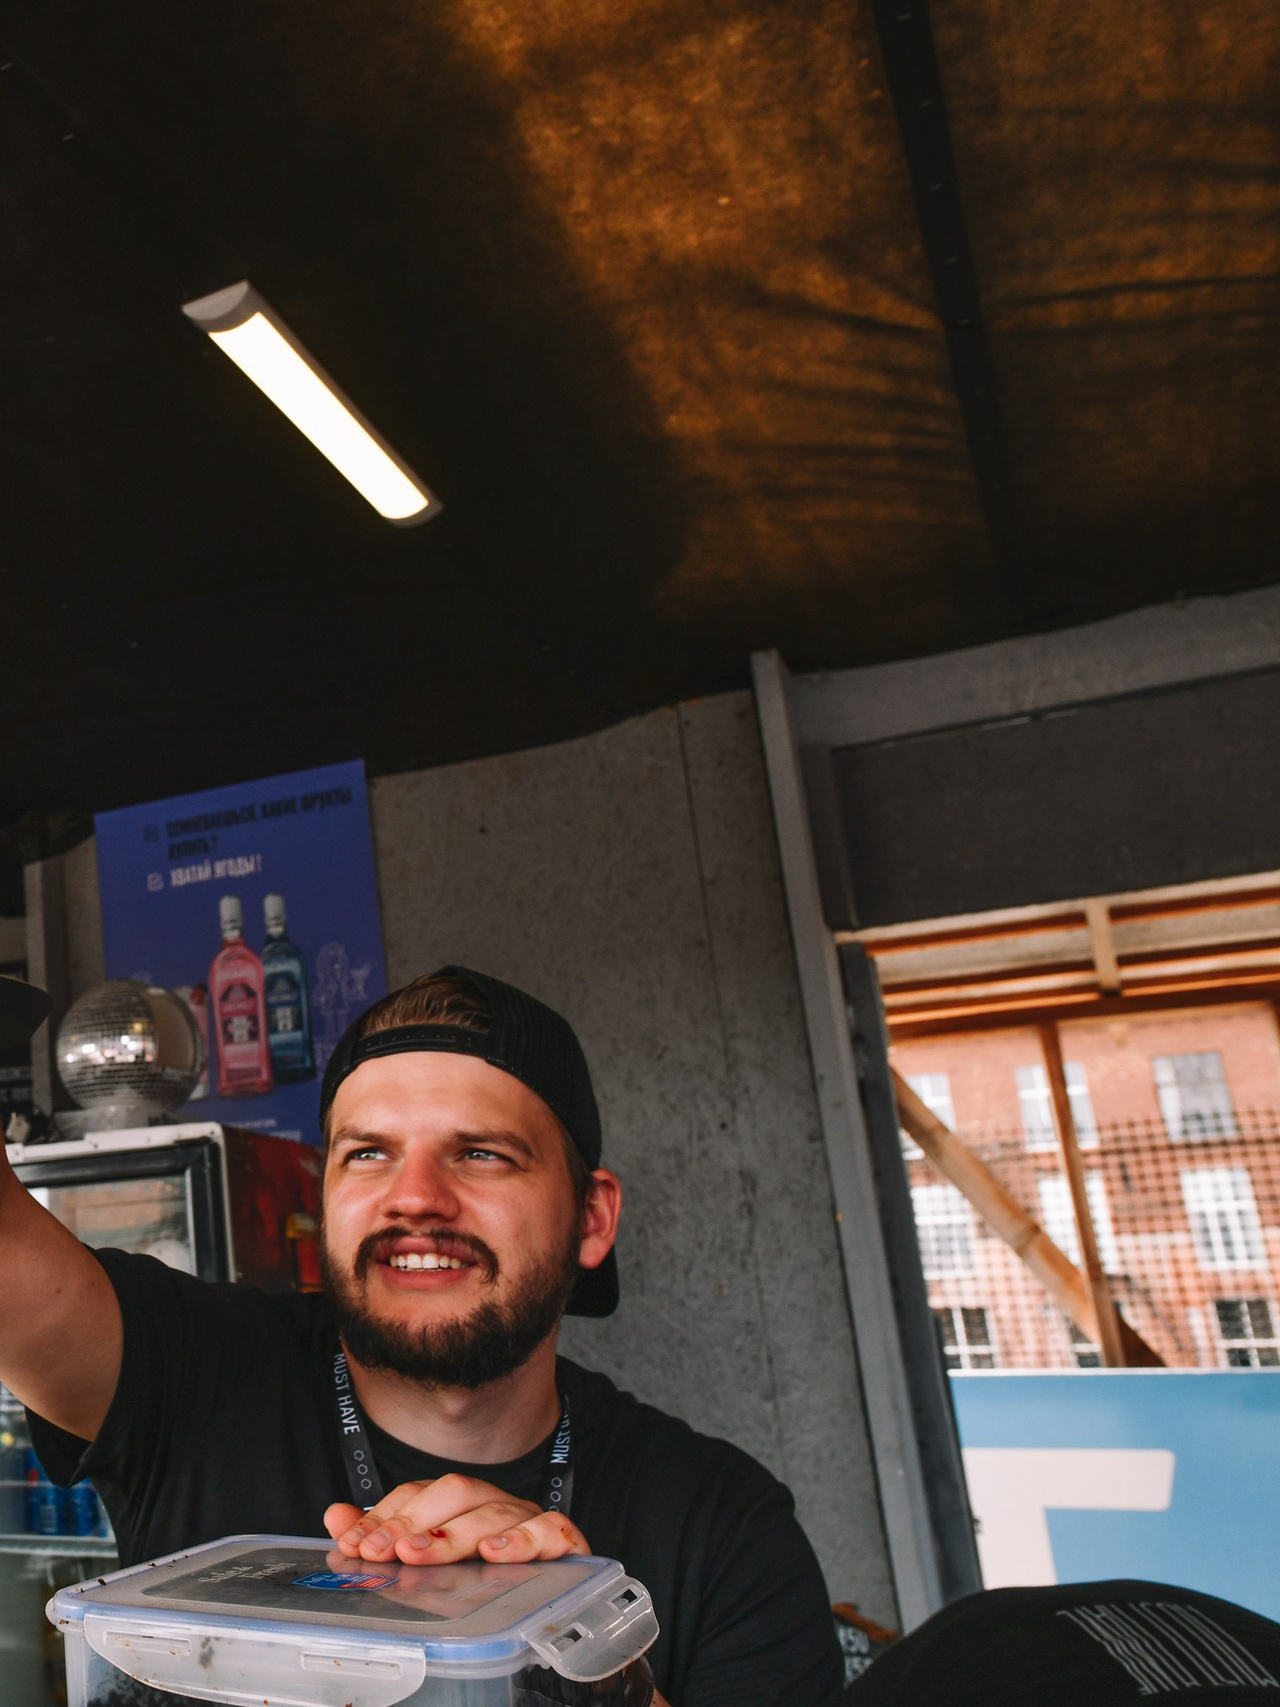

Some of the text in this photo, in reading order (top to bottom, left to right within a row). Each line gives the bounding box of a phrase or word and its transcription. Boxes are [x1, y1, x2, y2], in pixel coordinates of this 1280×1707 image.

[333, 1352, 361, 1435] MUST HAVE
[549, 1430, 571, 1464] MUST
